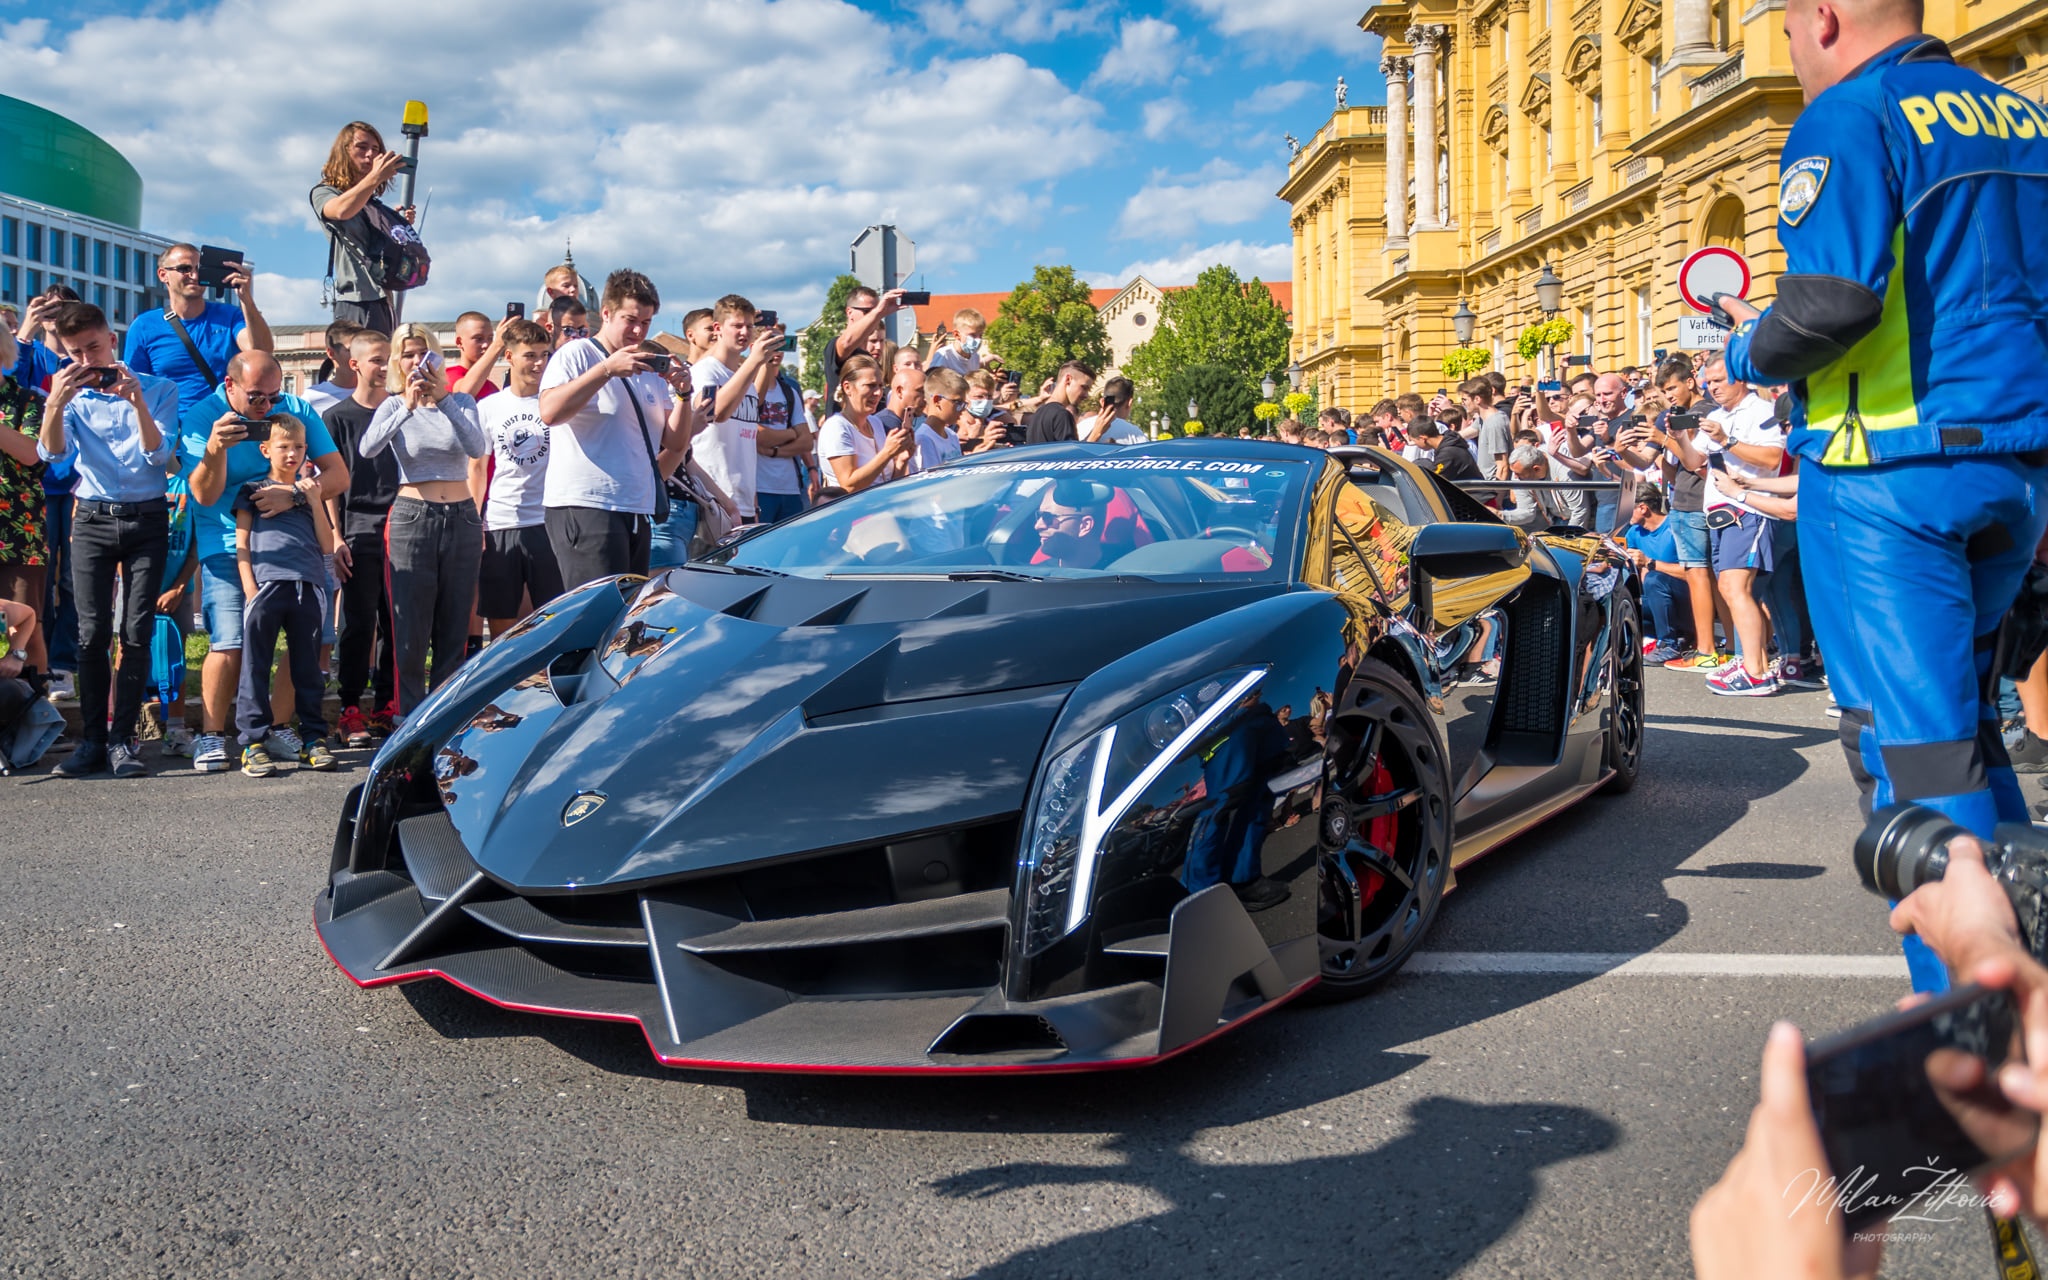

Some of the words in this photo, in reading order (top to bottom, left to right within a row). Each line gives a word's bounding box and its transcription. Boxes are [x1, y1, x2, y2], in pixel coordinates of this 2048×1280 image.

[1899, 90, 2048, 145] POLICI
[1698, 334, 1725, 345] pristu
[502, 415, 518, 429] JUST
[521, 413, 534, 421] DO
